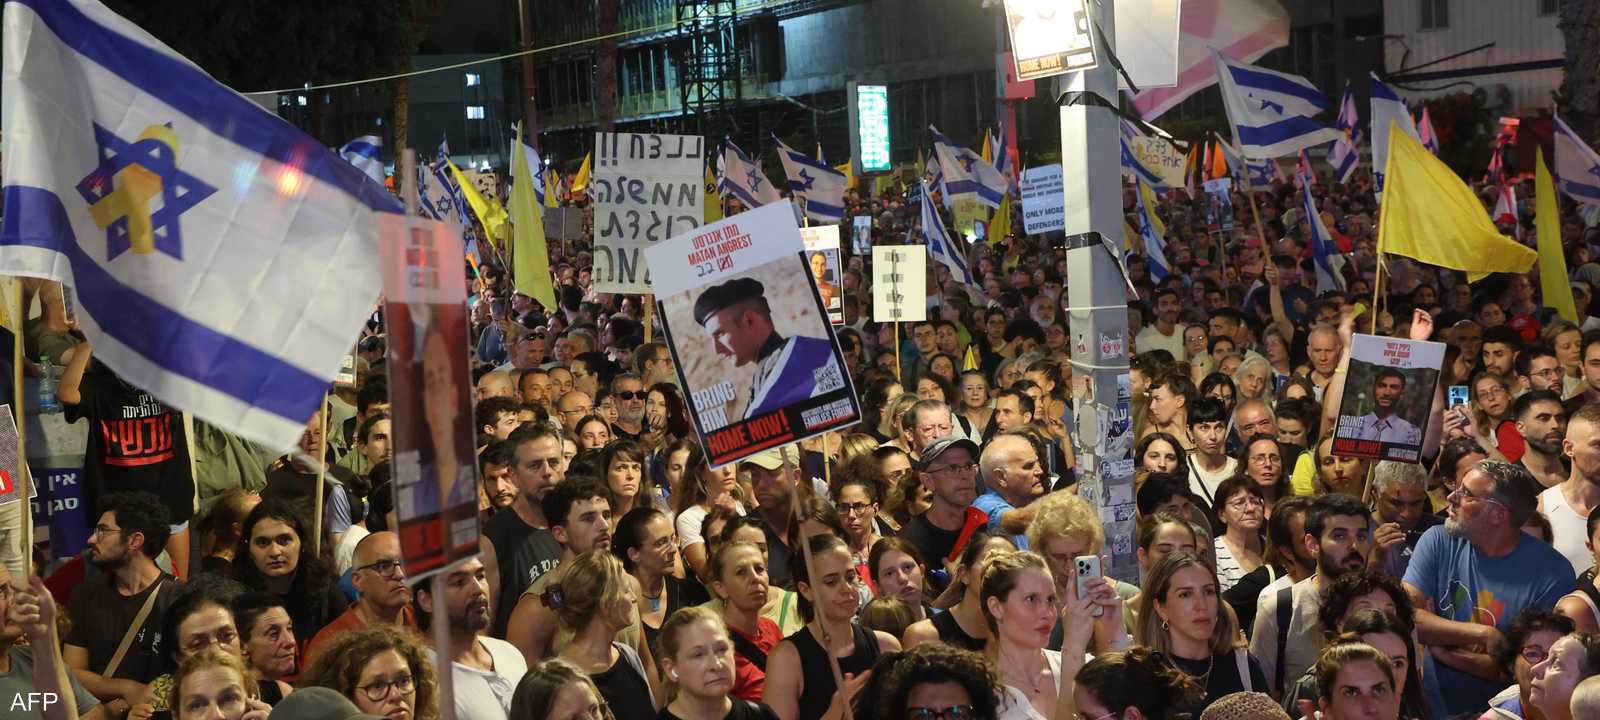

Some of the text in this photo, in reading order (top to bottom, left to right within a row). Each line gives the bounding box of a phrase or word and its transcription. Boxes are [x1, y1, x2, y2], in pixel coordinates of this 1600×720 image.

[596, 175, 697, 207] ממשלה
[1026, 208, 1043, 219] ONLY
[688, 233, 753, 266] MATAN ANGREST
[692, 381, 736, 410] BRING
[122, 404, 150, 419] הביתה
[699, 406, 729, 434] HIM
[1340, 415, 1364, 428] BRING
[100, 414, 172, 456] עכשיו
[707, 408, 790, 455] HOME NOW!
